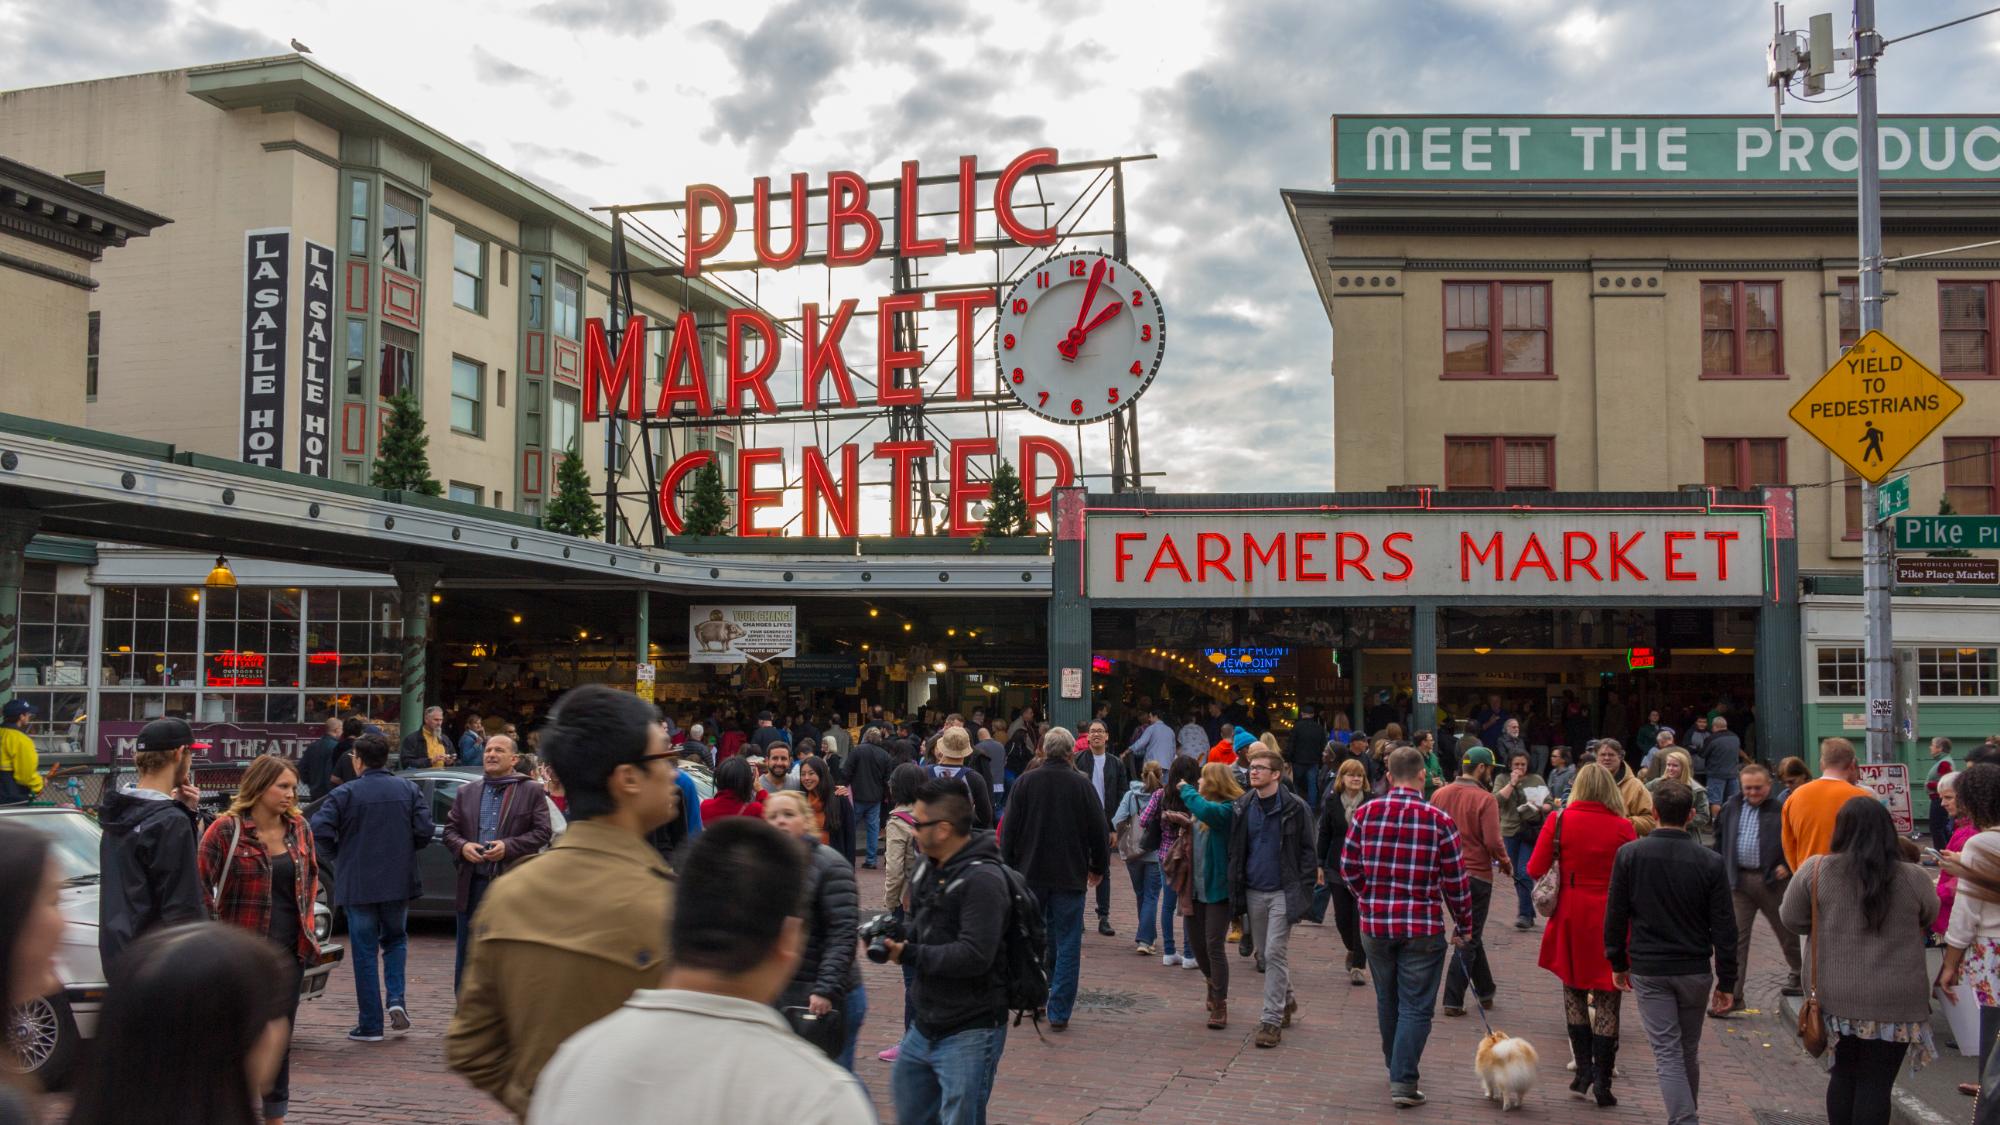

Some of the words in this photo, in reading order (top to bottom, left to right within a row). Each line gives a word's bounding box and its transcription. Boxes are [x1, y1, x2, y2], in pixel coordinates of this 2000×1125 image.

[1366, 126, 1532, 172] MEET
[1570, 126, 1688, 172] THE
[684, 147, 1059, 277] PUBLIC
[252, 240, 280, 281] LA
[309, 247, 328, 292] LA
[1069, 259, 1086, 277] 12
[1037, 271, 1050, 289] 11
[1109, 266, 1115, 283] 1
[1012, 298, 1028, 315] 10
[1132, 290, 1143, 306] 2
[251, 288, 280, 395] SALLE
[1003, 333, 1016, 350] 9
[1141, 324, 1152, 342] 3
[306, 301, 327, 405] SALLE
[582, 289, 997, 422] MARKET
[1129, 360, 1143, 377] 4
[1846, 356, 1903, 375] YIELD
[1012, 367, 1024, 384] 8
[1862, 377, 1886, 394] TO
[1037, 391, 1049, 408] 7
[1107, 387, 1119, 404] 5
[1071, 399, 1084, 416] 6
[1810, 394, 1940, 418] PEDESTRIANS
[659, 436, 1076, 537] CENTER
[1905, 519, 1963, 544] Pike
[1979, 526, 1998, 544] Pl
[1115, 531, 1414, 583] FARMERS
[1460, 531, 1739, 582] MARKET
[1900, 569, 1924, 579] Pike
[1926, 569, 1954, 579] Place
[1956, 570, 1996, 580] Market
[733, 610, 755, 622] YOUR
